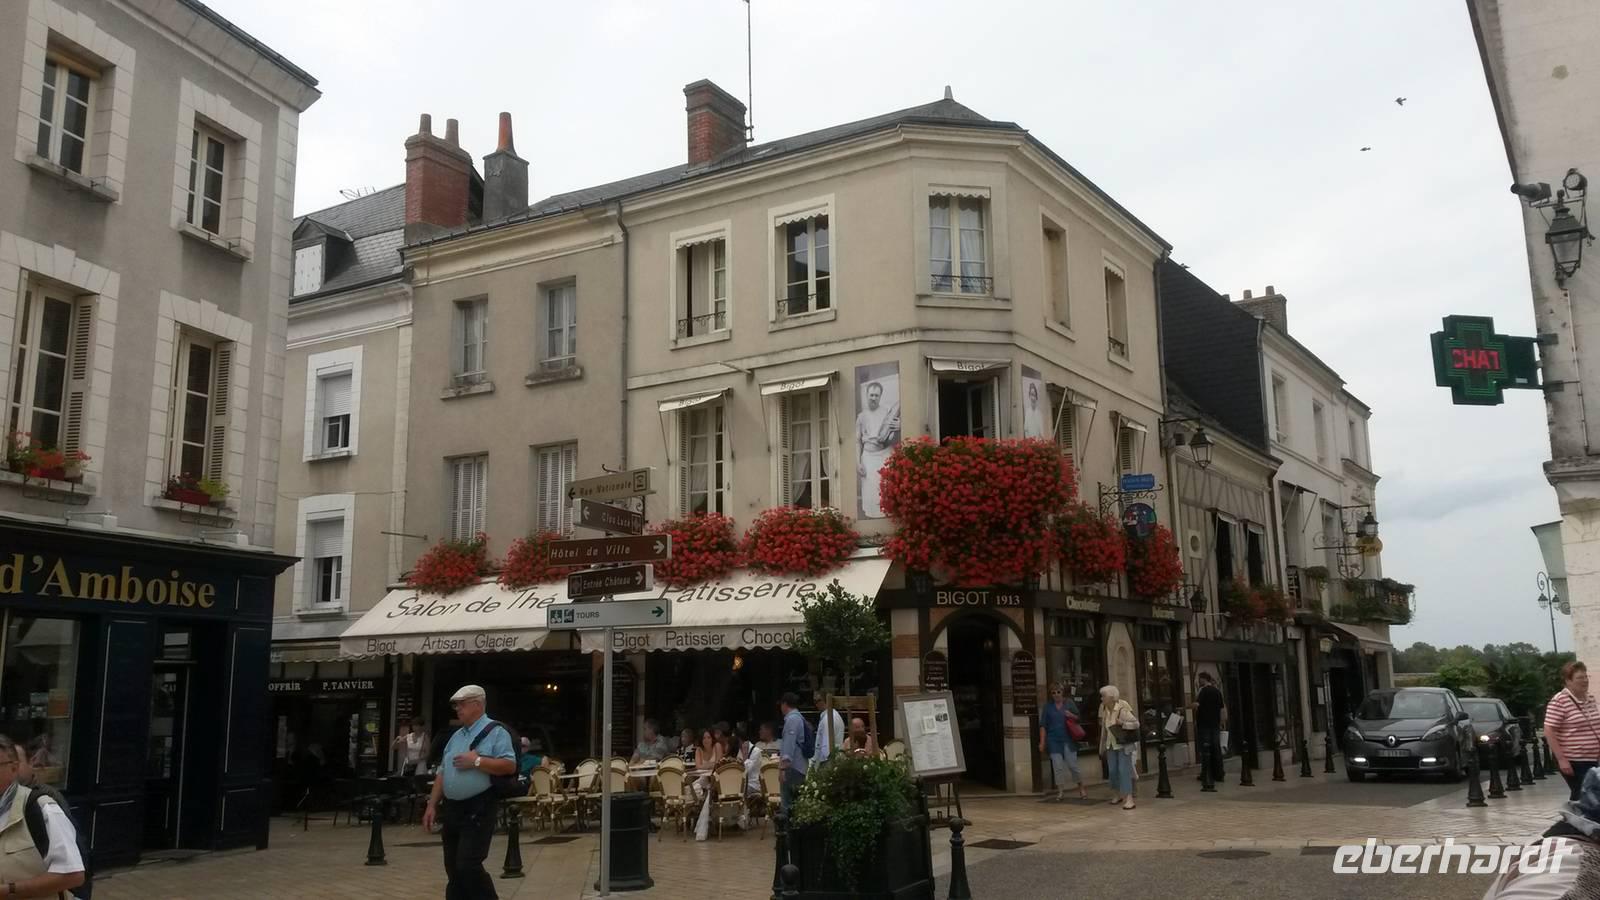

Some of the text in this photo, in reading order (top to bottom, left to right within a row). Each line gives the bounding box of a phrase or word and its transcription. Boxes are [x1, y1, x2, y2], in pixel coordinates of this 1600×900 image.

[550, 544, 631, 559] Hôtel de Ville
[0, 553, 216, 609] d'Amboise
[386, 586, 558, 618] Salon de Thé
[936, 591, 1020, 606] BIGOT 1913
[576, 611, 600, 619] TOURS
[367, 633, 518, 653] Bigot Artisan Glacier
[613, 632, 650, 650] Bigot
[665, 630, 726, 647] Patissier
